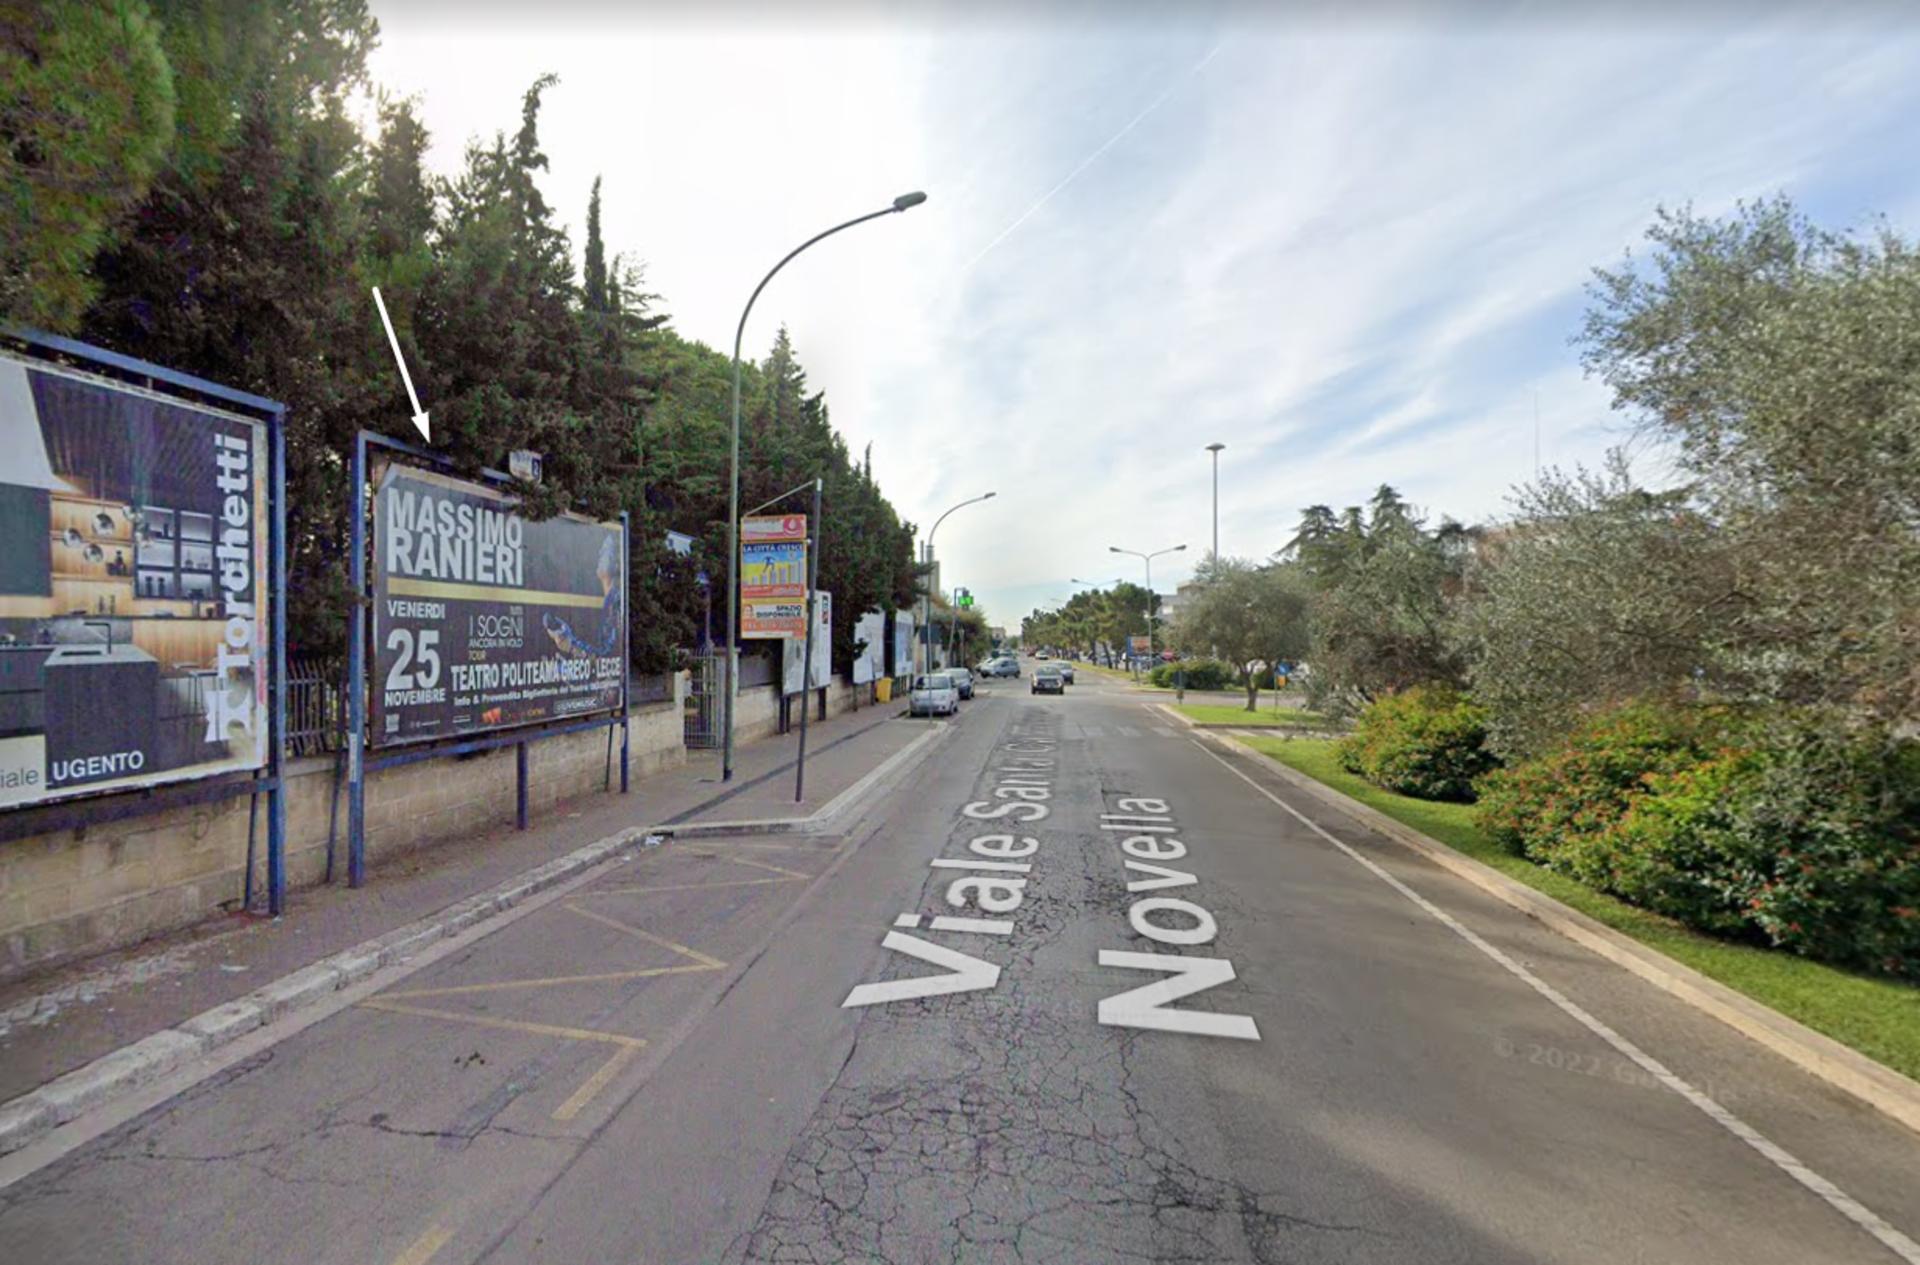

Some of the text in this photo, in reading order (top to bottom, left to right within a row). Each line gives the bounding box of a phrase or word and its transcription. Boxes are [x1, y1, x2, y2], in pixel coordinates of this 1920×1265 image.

[387, 487, 523, 549] MASSIMO
[215, 432, 252, 677] Torchetti
[387, 530, 524, 586] RANIERI
[469, 615, 524, 637] I SOGNI
[386, 627, 441, 690] 25
[449, 663, 499, 692] TEATRO
[502, 660, 558, 687] POLITEAMA
[561, 659, 591, 681] GRECO
[385, 688, 446, 707] NOVEMBRE
[53, 750, 144, 781] UGENTO
